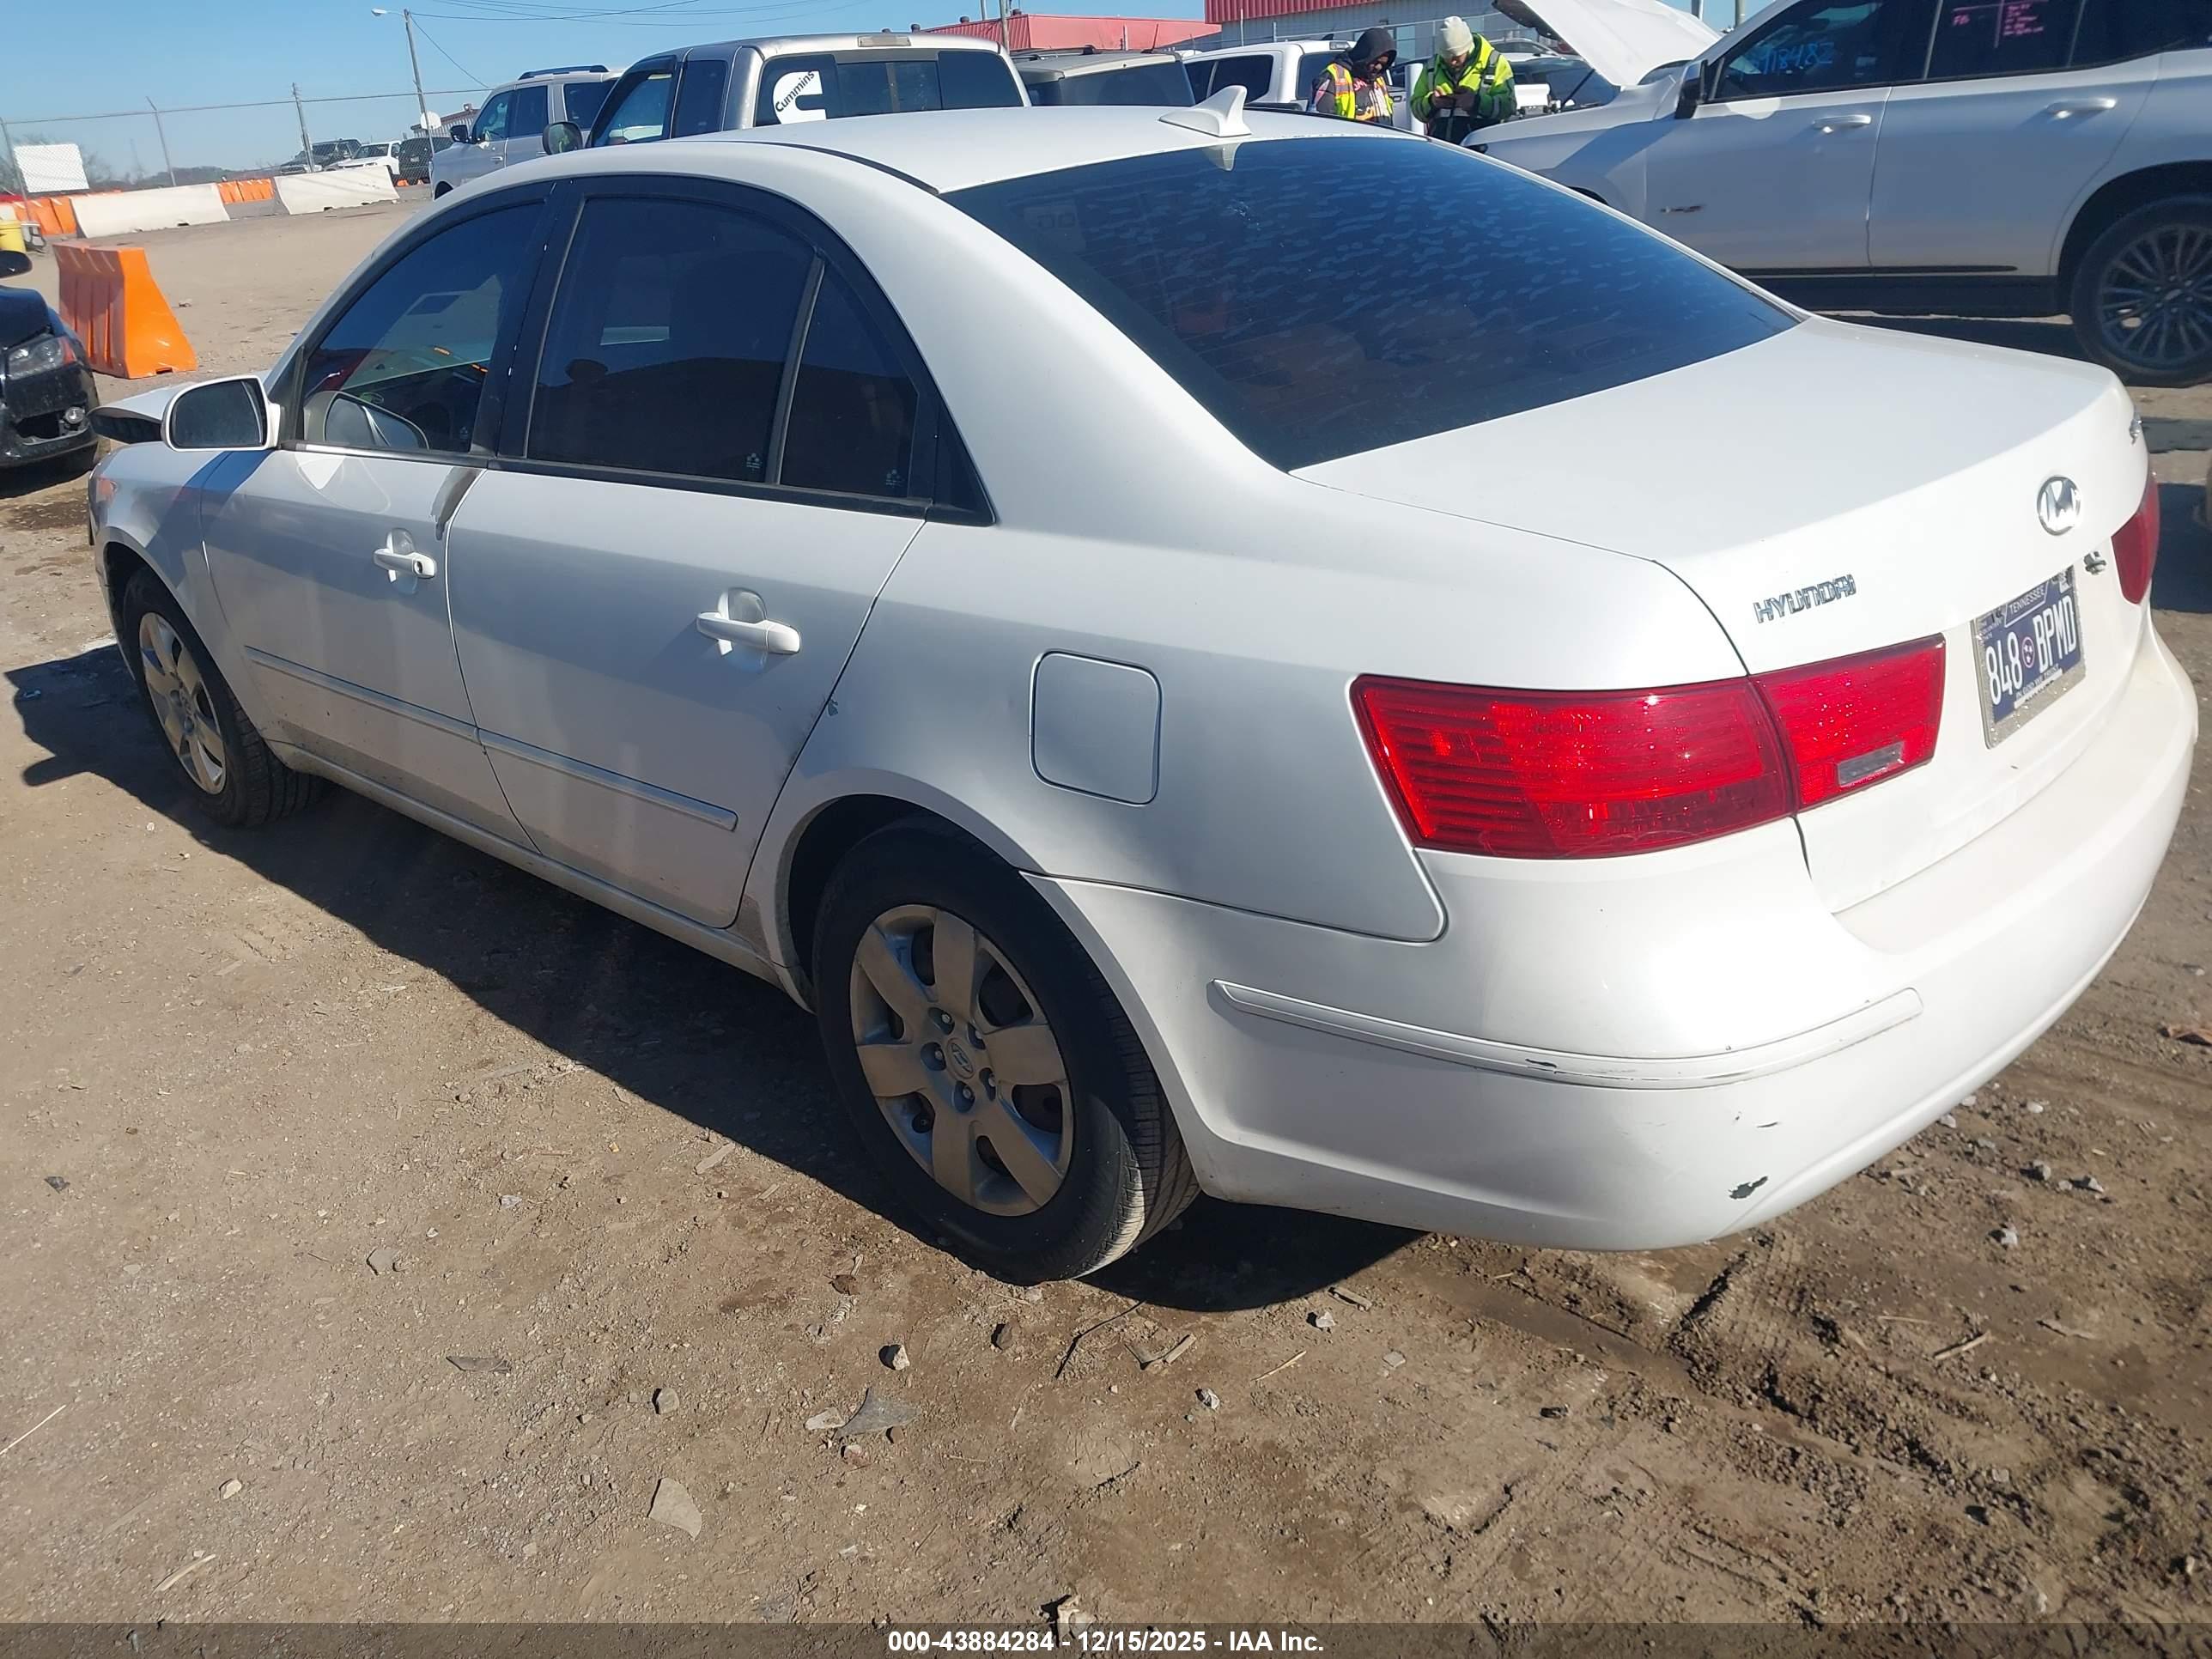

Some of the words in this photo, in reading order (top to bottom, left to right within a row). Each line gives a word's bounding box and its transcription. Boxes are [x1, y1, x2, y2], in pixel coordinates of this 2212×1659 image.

[775, 71, 815, 112] Cummins
[1753, 574, 1856, 624] HYUNDAI
[2009, 585, 2045, 615] TENNESSEE
[1985, 632, 2023, 705] 848
[2033, 595, 2076, 674] BPMD
